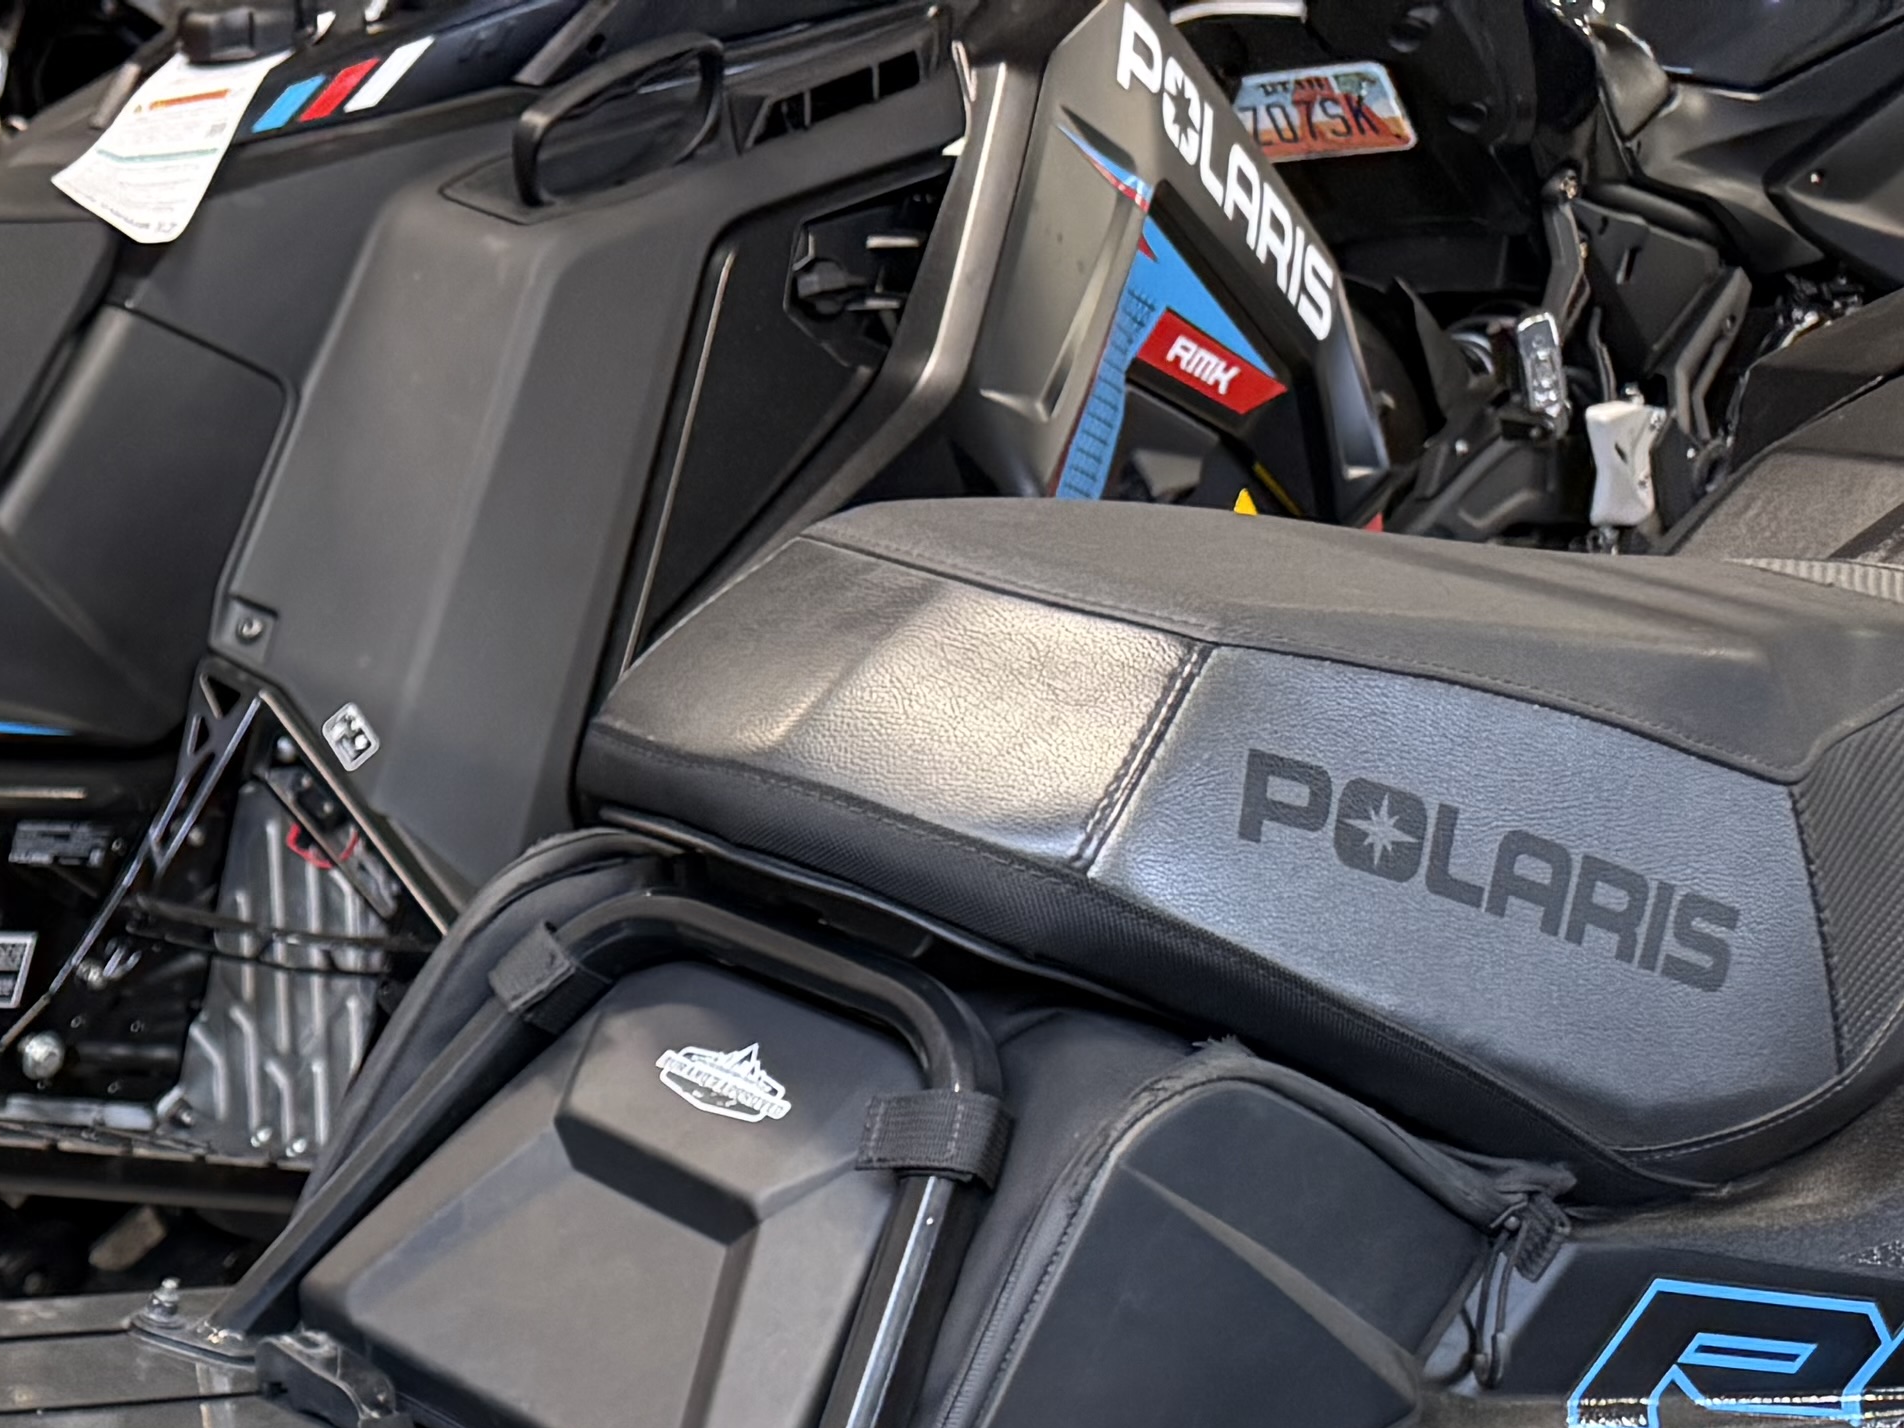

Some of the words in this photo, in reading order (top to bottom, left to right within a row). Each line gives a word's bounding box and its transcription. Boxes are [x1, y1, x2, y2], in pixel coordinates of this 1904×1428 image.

[1116, 2, 1335, 341] POLARIS
[1166, 334, 1241, 396] RMK
[1237, 747, 1741, 993] POLARIS
